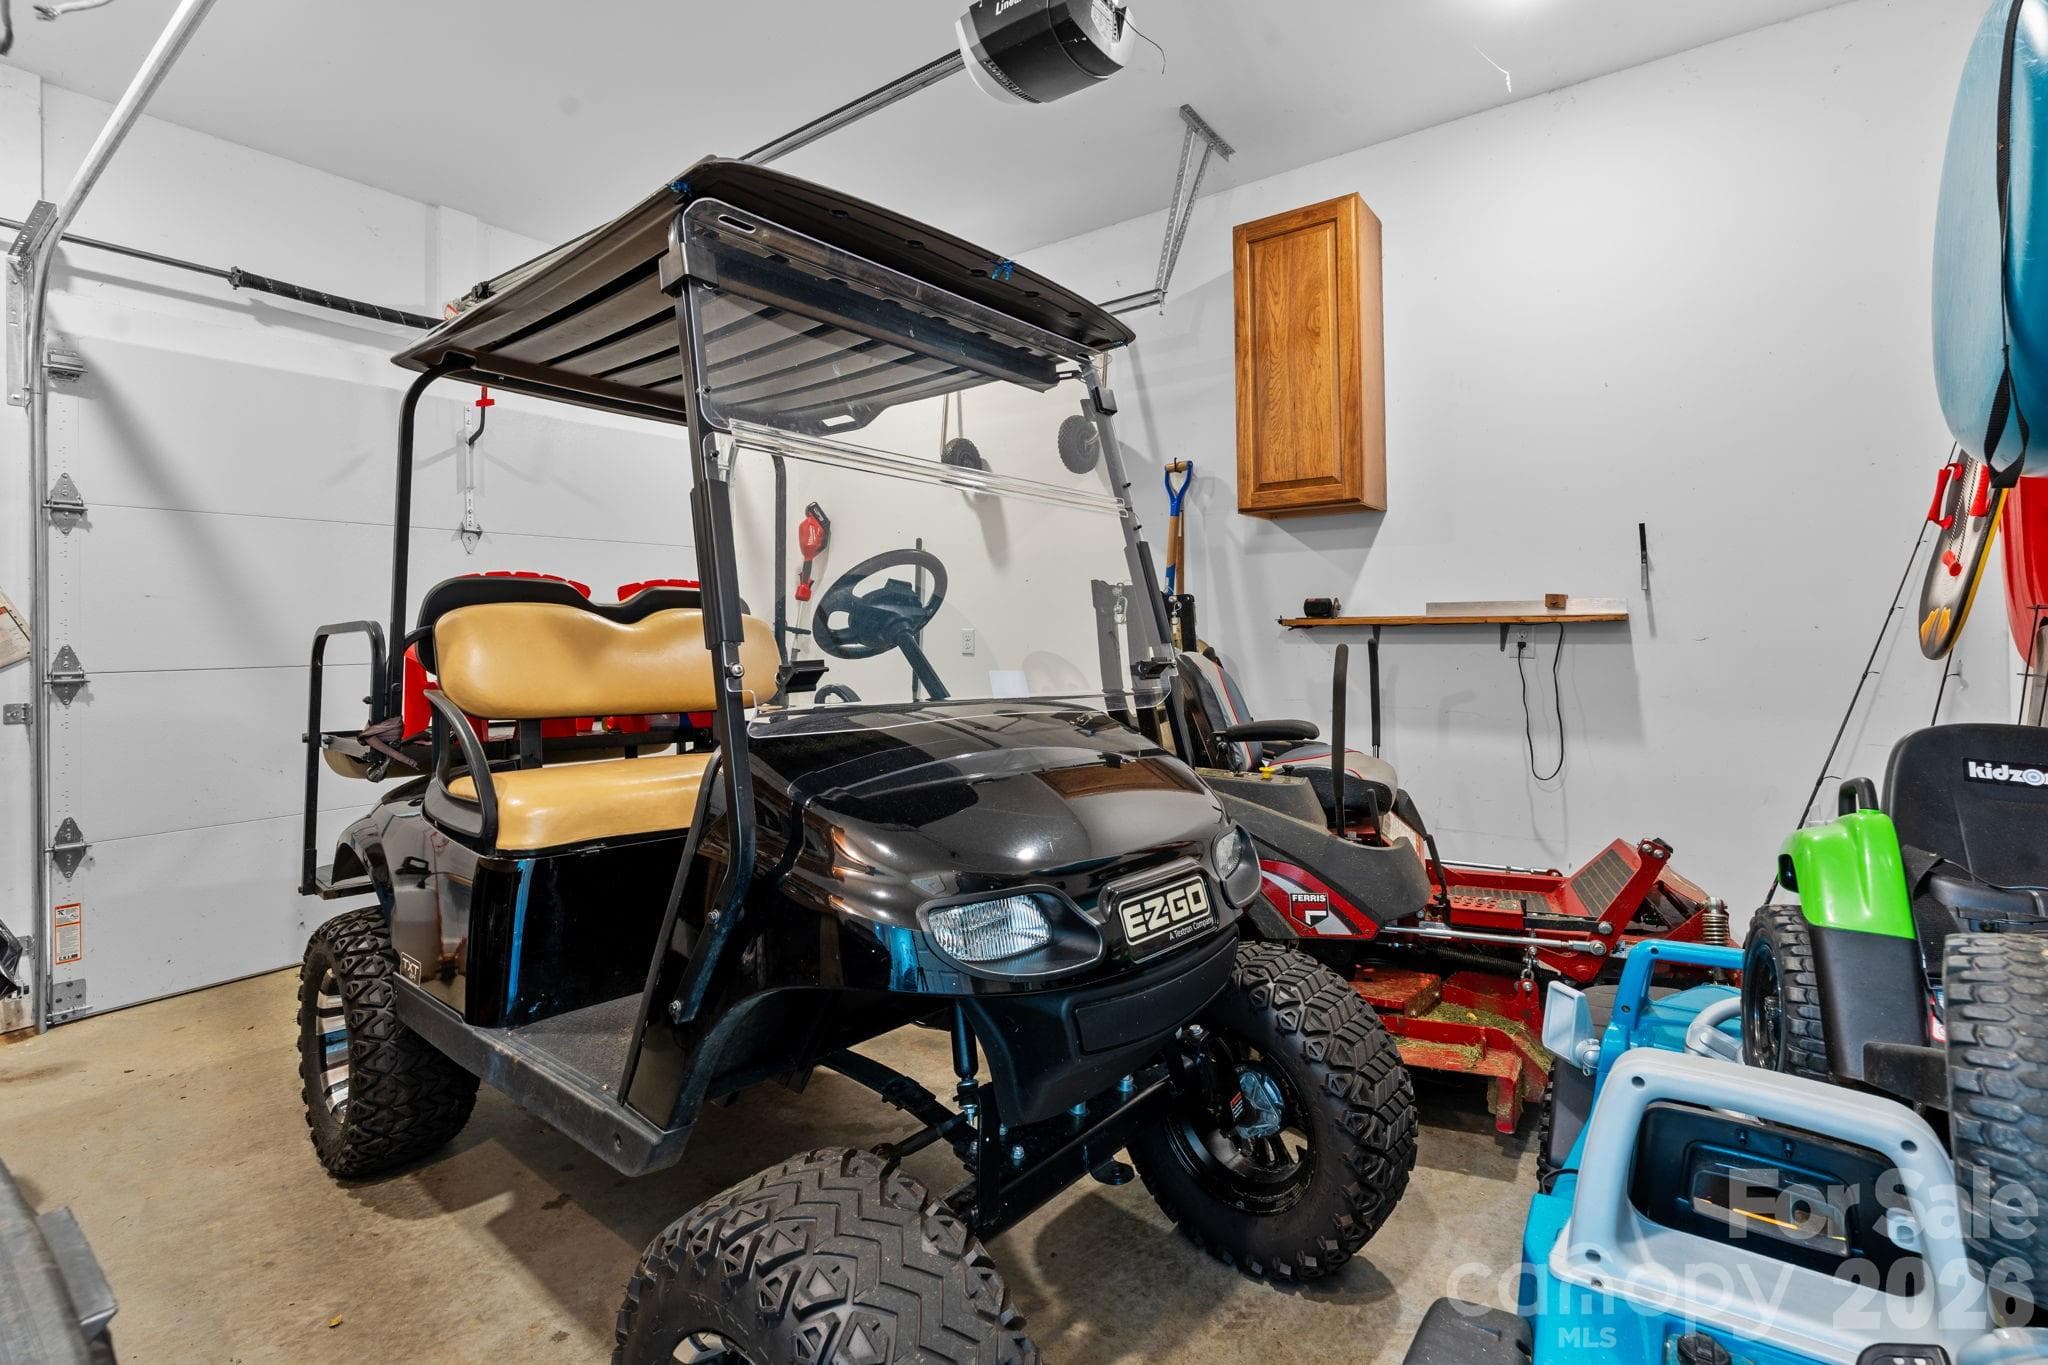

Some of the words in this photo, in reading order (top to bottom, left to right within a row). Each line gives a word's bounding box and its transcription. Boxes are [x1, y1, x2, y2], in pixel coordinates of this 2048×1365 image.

[1292, 894, 1327, 903] FERRIS
[1173, 924, 1194, 938] Textron
[1193, 916, 1214, 930] Company
[402, 957, 420, 976] TXT
